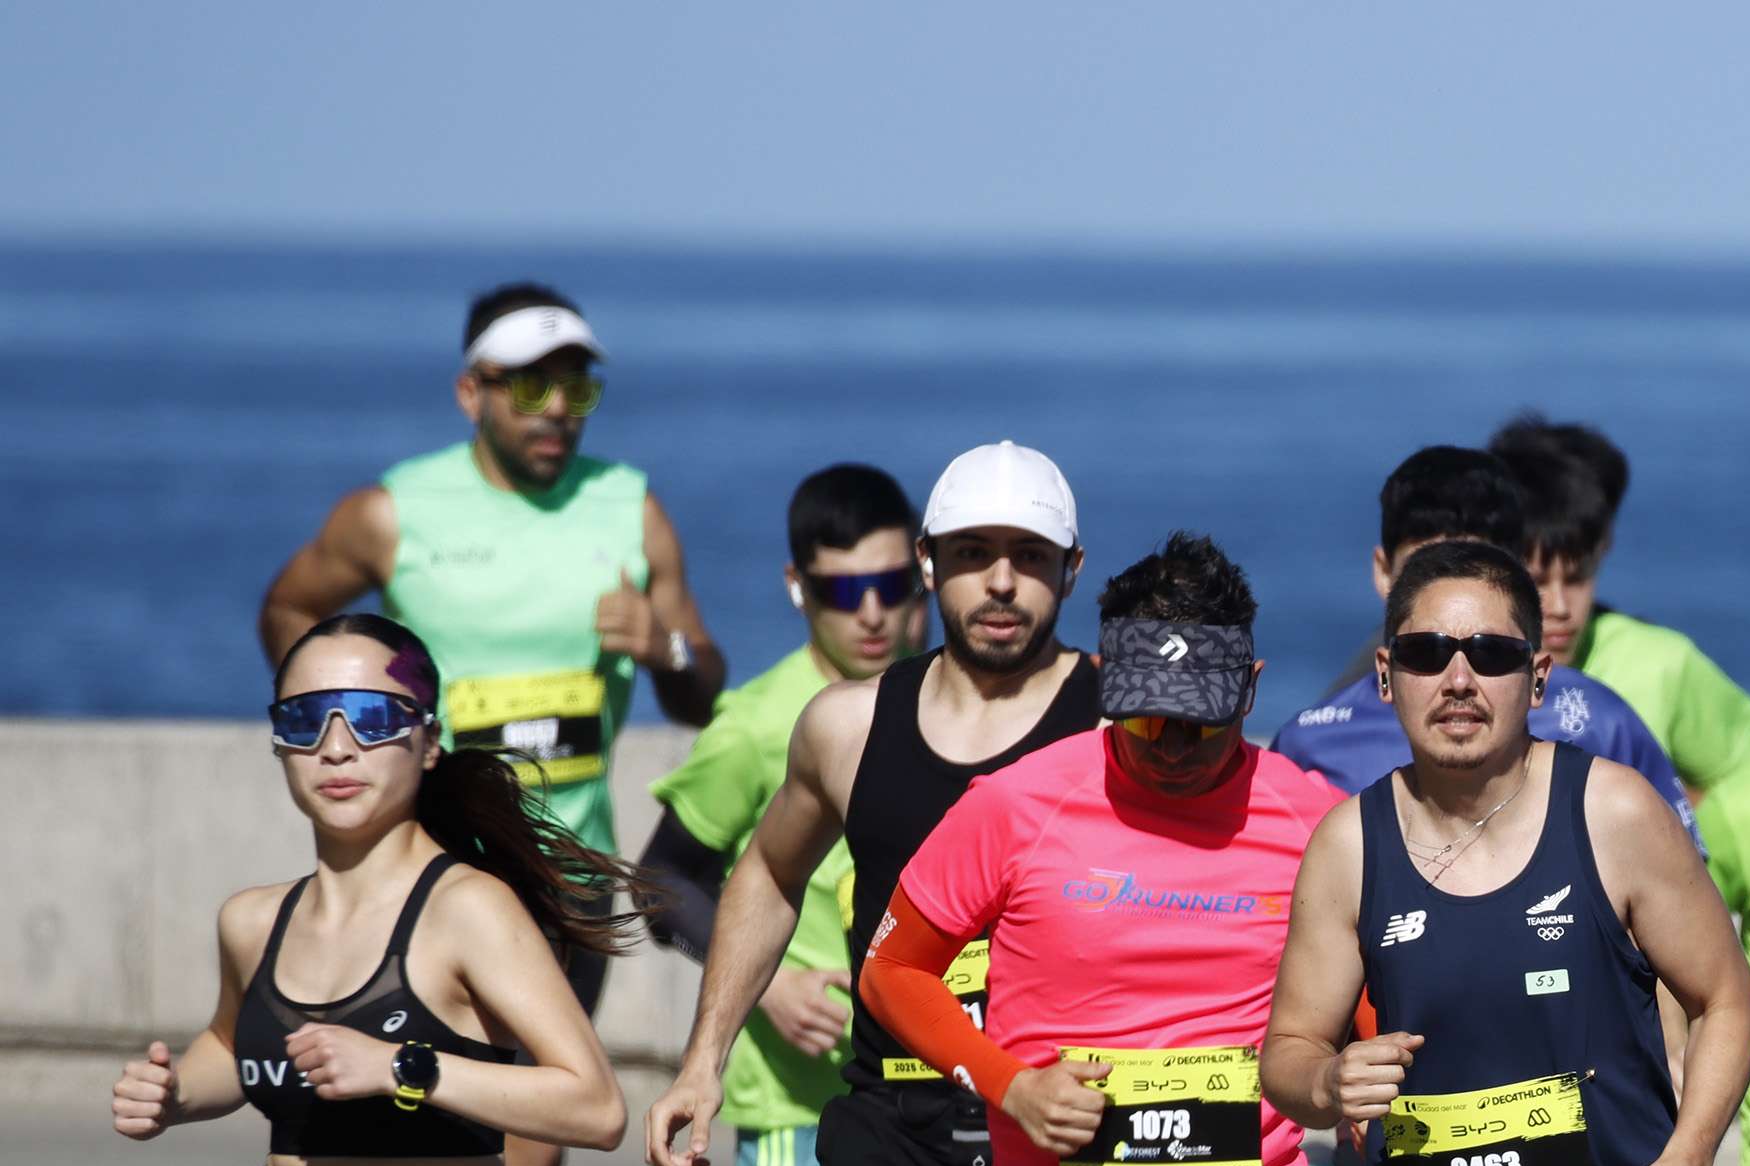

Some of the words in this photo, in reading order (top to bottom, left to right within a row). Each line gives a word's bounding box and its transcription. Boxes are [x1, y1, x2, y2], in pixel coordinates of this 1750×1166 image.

[1177, 1054, 1233, 1065] DECATHLON
[1133, 1079, 1187, 1091] BYD
[1492, 1086, 1552, 1106] DECATHLON
[1128, 1109, 1191, 1140] 1073
[1450, 1120, 1507, 1138] BYD
